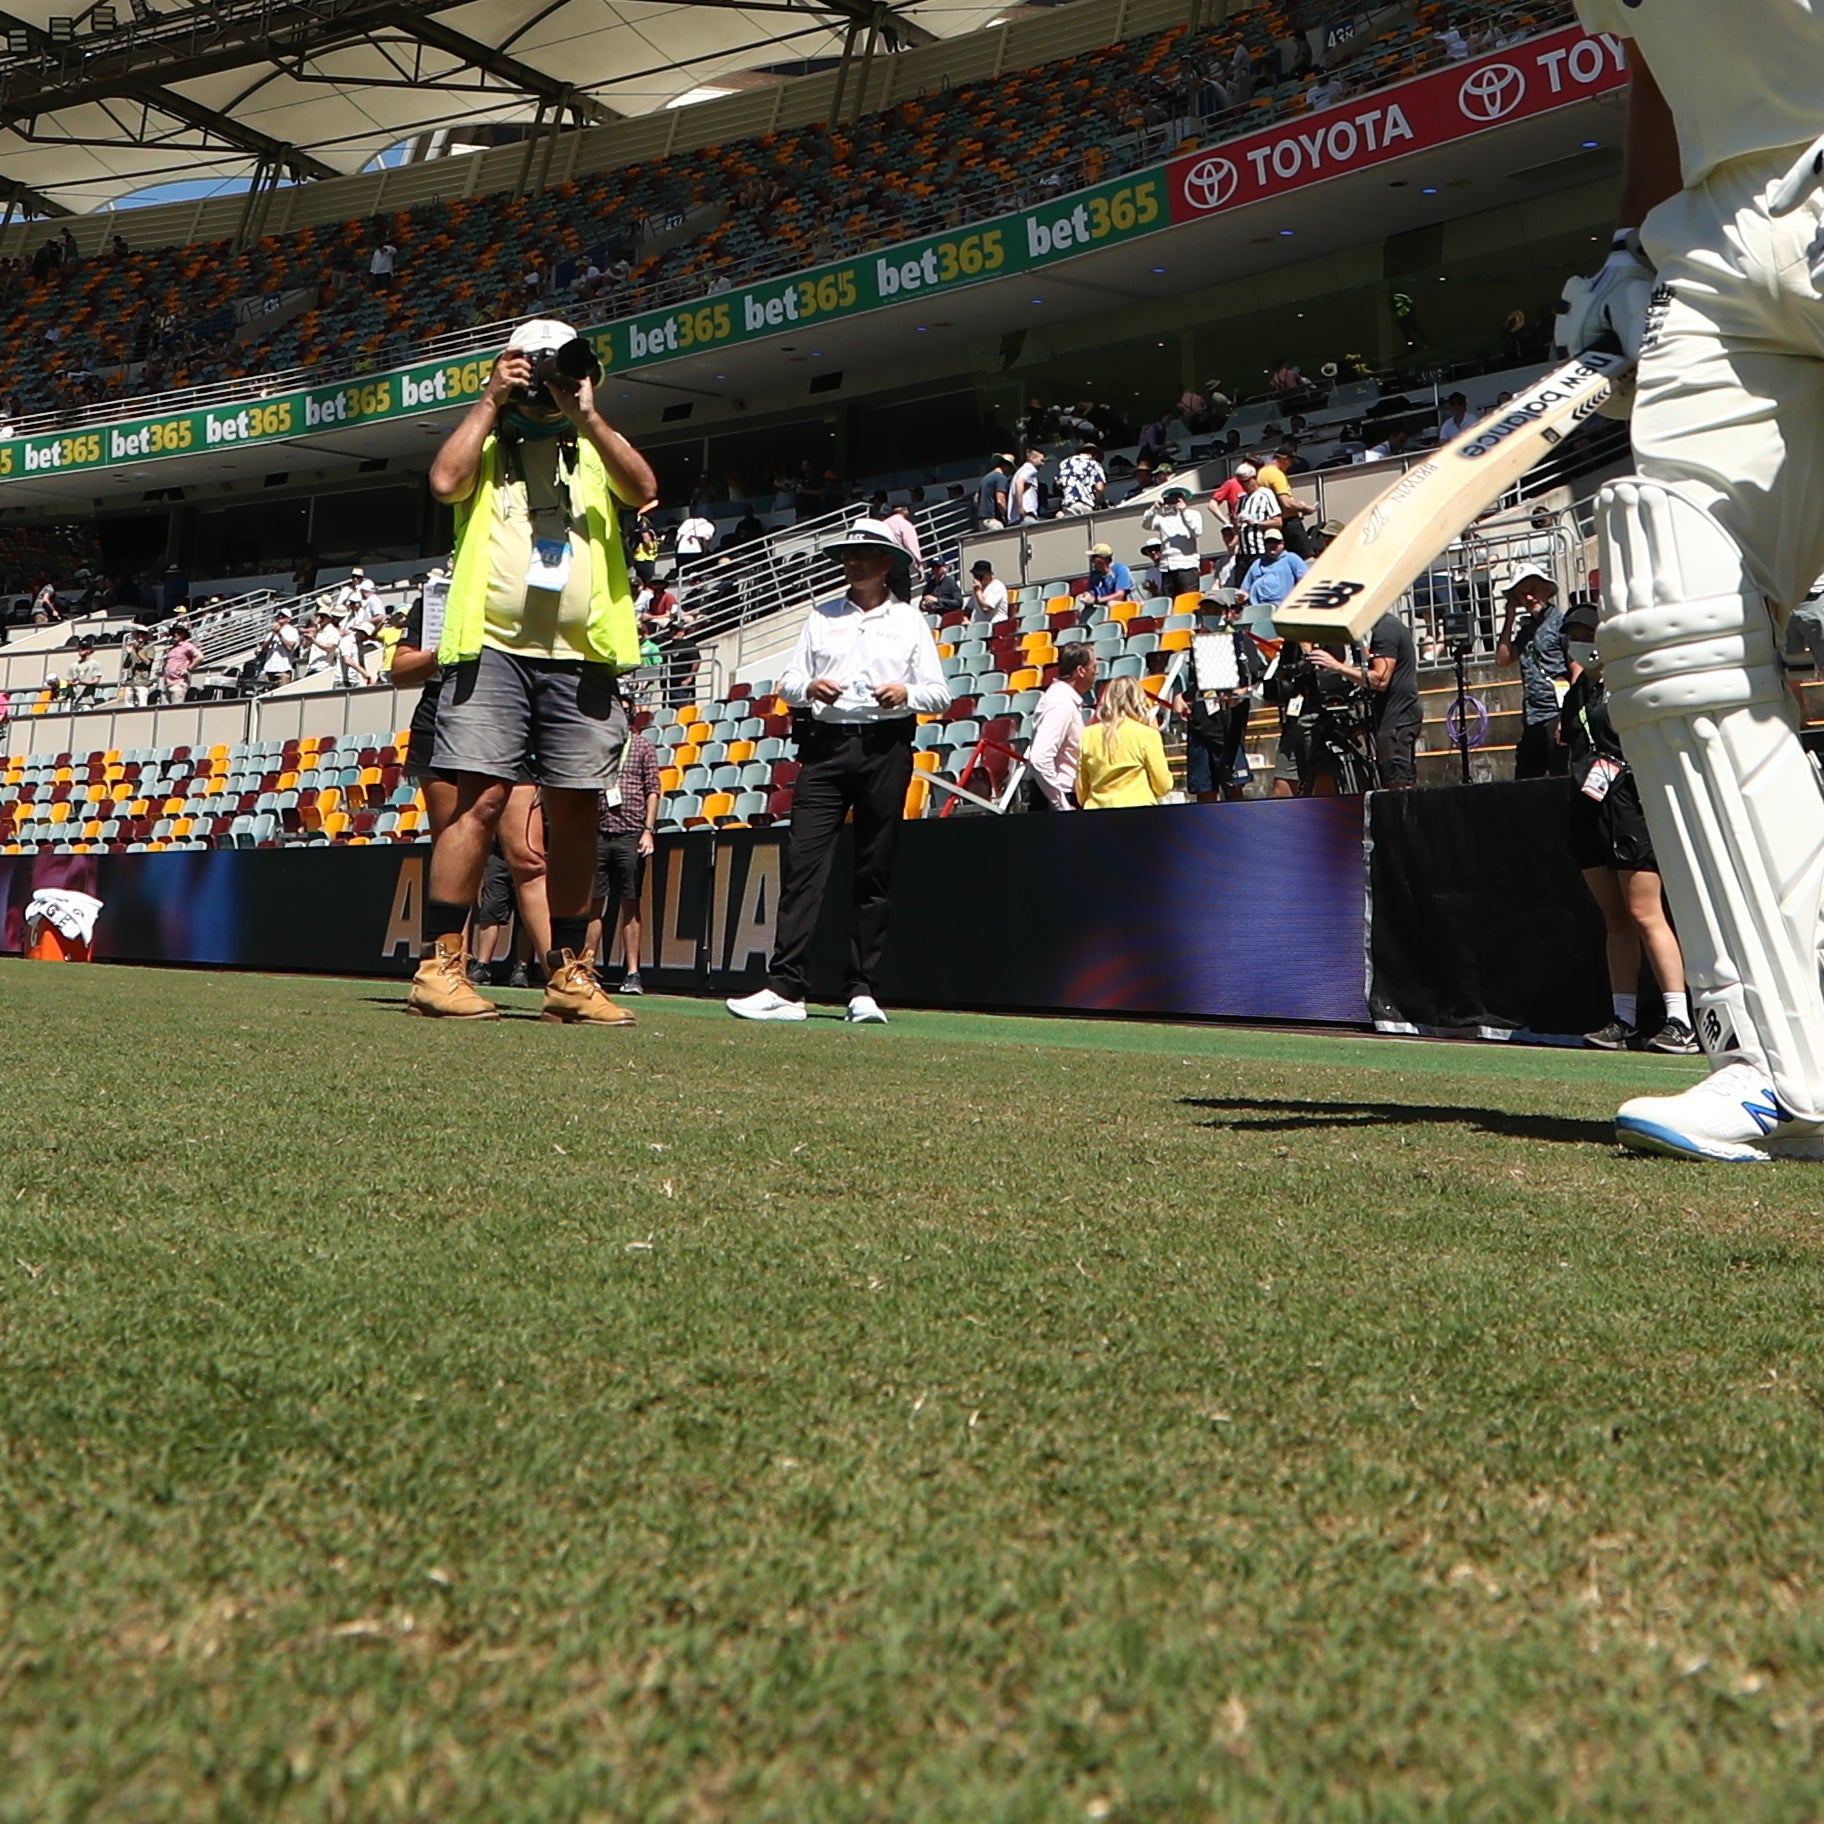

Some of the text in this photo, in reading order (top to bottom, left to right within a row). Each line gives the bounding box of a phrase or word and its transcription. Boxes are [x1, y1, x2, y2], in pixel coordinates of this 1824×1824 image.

[1535, 33, 1626, 93] TOY
[1247, 103, 1415, 186] TOYOTA
[1026, 181, 1159, 258] bet365
[877, 229, 1004, 298] bet365
[745, 270, 857, 331] bet365
[629, 303, 730, 359] bet365
[206, 402, 292, 443] bet365
[305, 382, 391, 426] bet365
[1459, 355, 1613, 458] new balance
[24, 435, 101, 470] bet365
[111, 420, 192, 459] bet365
